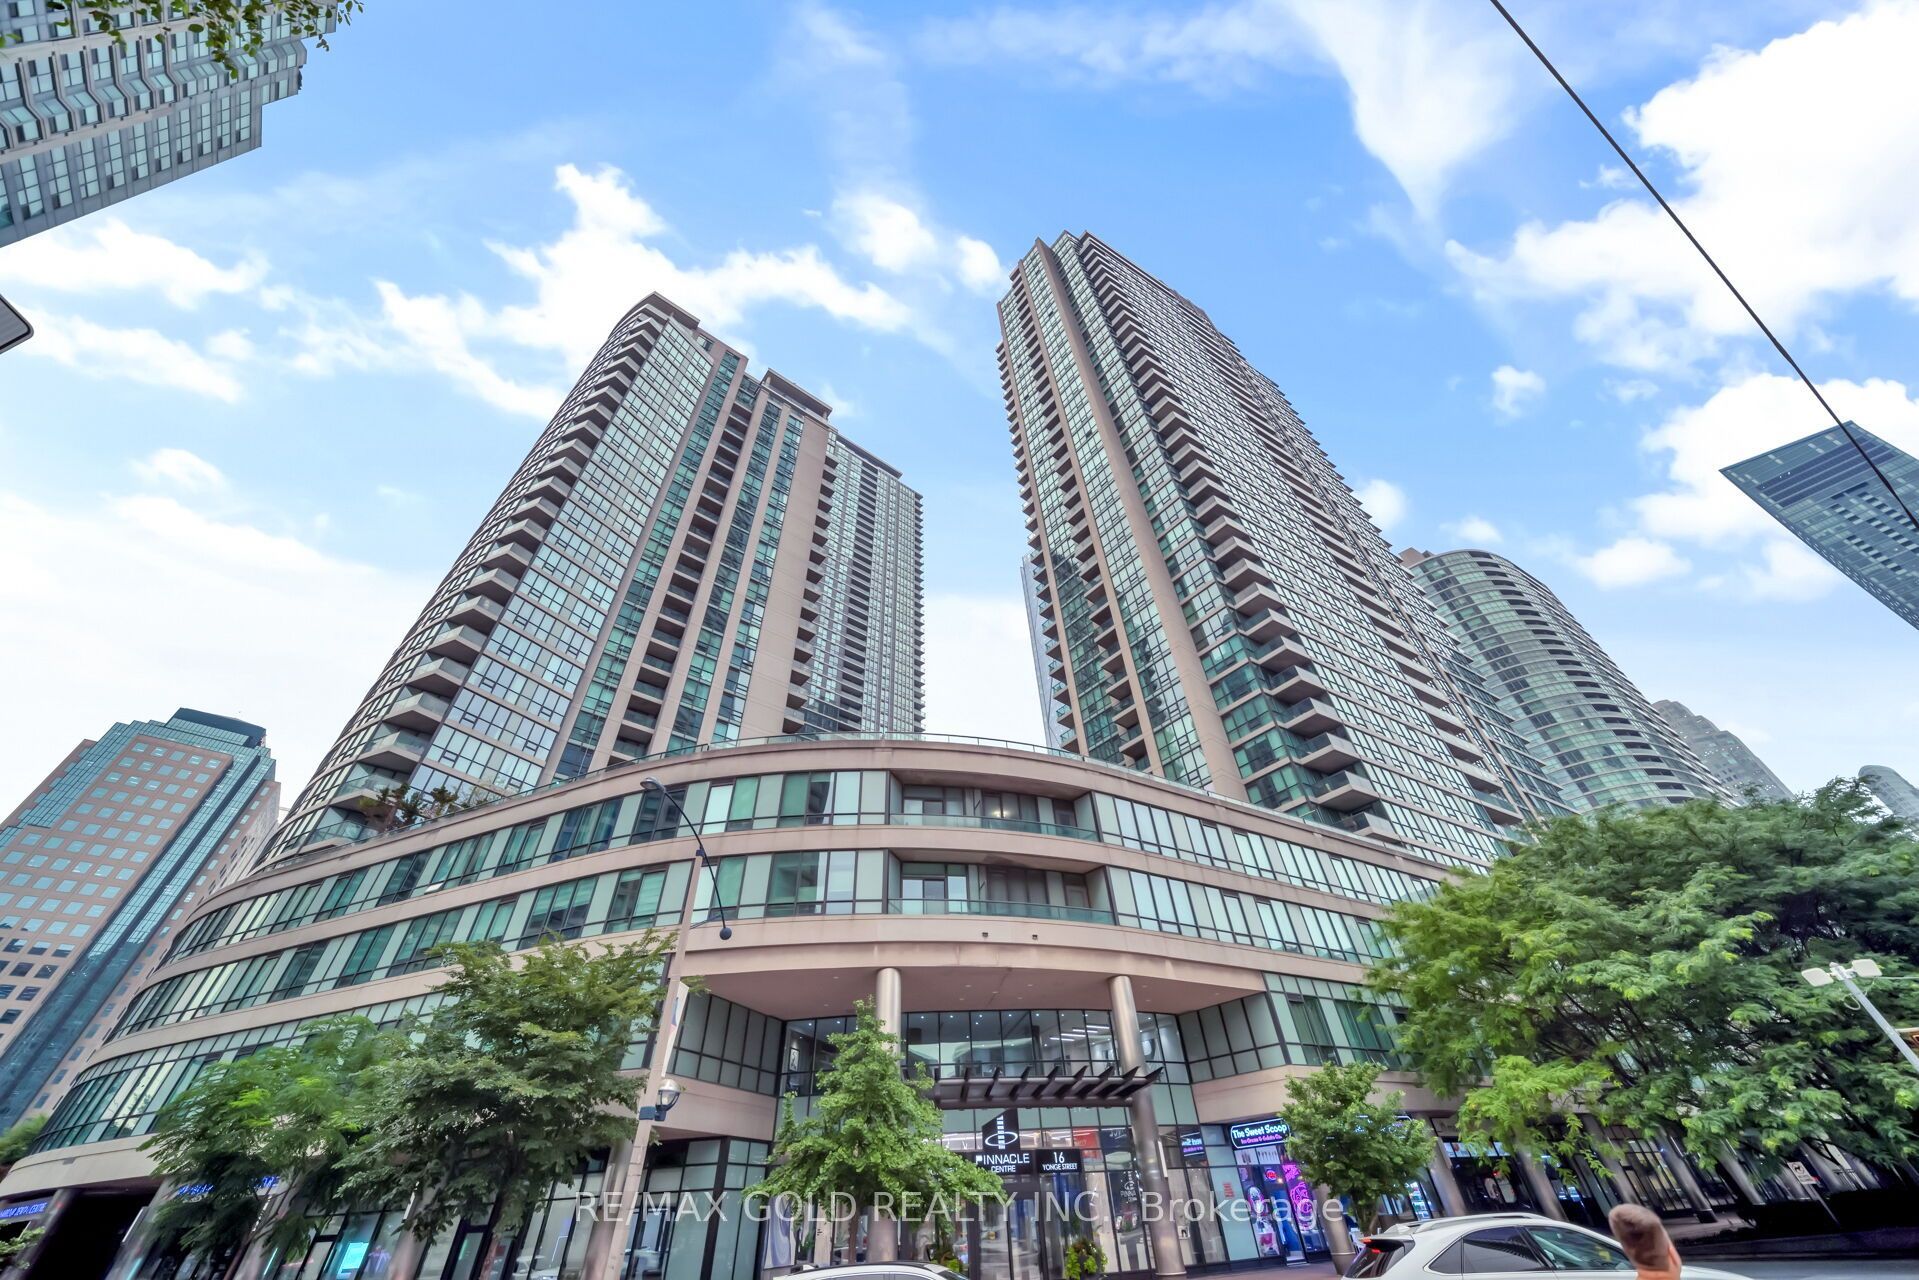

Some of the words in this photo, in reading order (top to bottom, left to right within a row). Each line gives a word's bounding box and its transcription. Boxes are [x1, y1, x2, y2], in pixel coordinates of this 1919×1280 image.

[1232, 1130, 1245, 1139] The
[1245, 1126, 1264, 1137] Sweet
[1264, 1124, 1287, 1134] Scoop
[976, 1153, 1030, 1165] PINNACLE
[1053, 1152, 1065, 1163] 16
[991, 1165, 1016, 1173] CENTRE
[1042, 1163, 1061, 1171] YONGE
